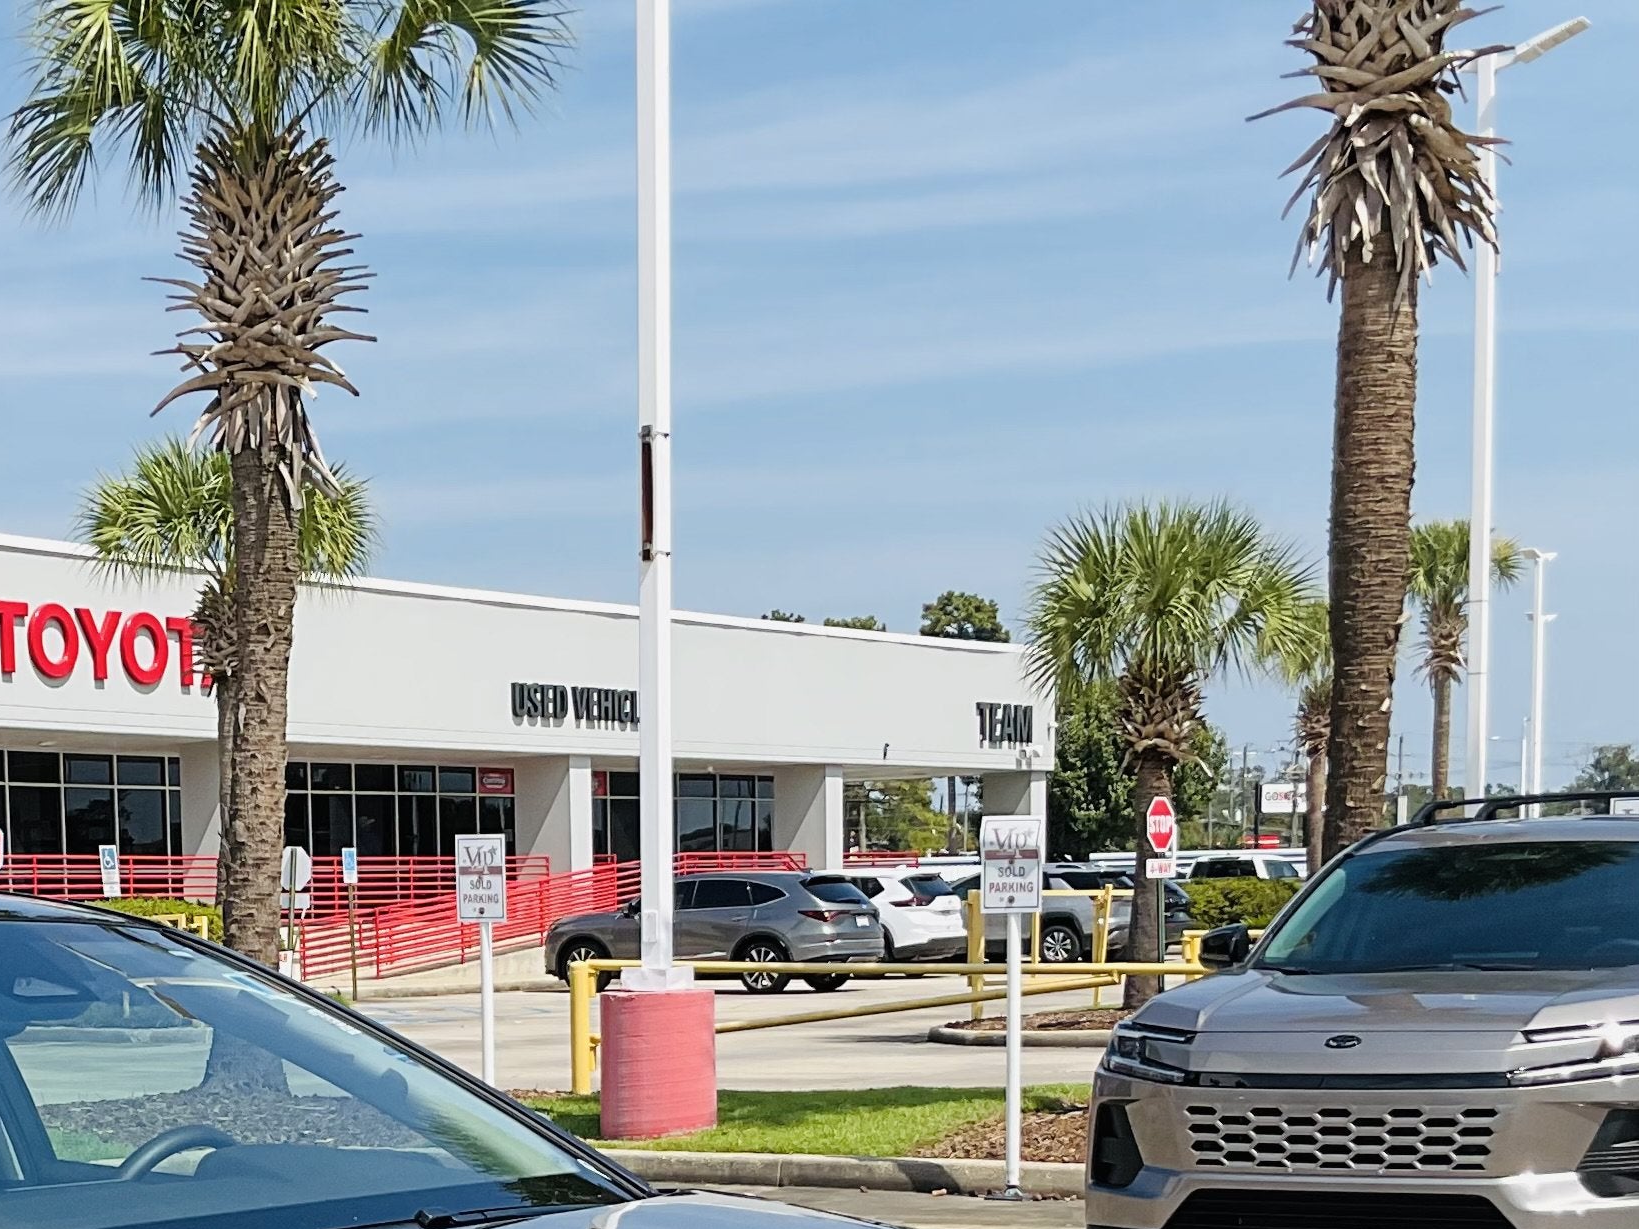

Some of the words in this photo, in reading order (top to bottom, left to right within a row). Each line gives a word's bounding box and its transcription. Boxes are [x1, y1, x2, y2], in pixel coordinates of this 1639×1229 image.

[510, 682, 568, 719] USED
[975, 702, 1033, 743] TEAM
[1149, 815, 1173, 833] STOP
[997, 866, 1026, 877] SOLD
[1149, 863, 1172, 874] 4-WAY
[469, 880, 492, 890] SOLD
[989, 881, 1034, 893] PARKING
[463, 893, 499, 904] PARKING
